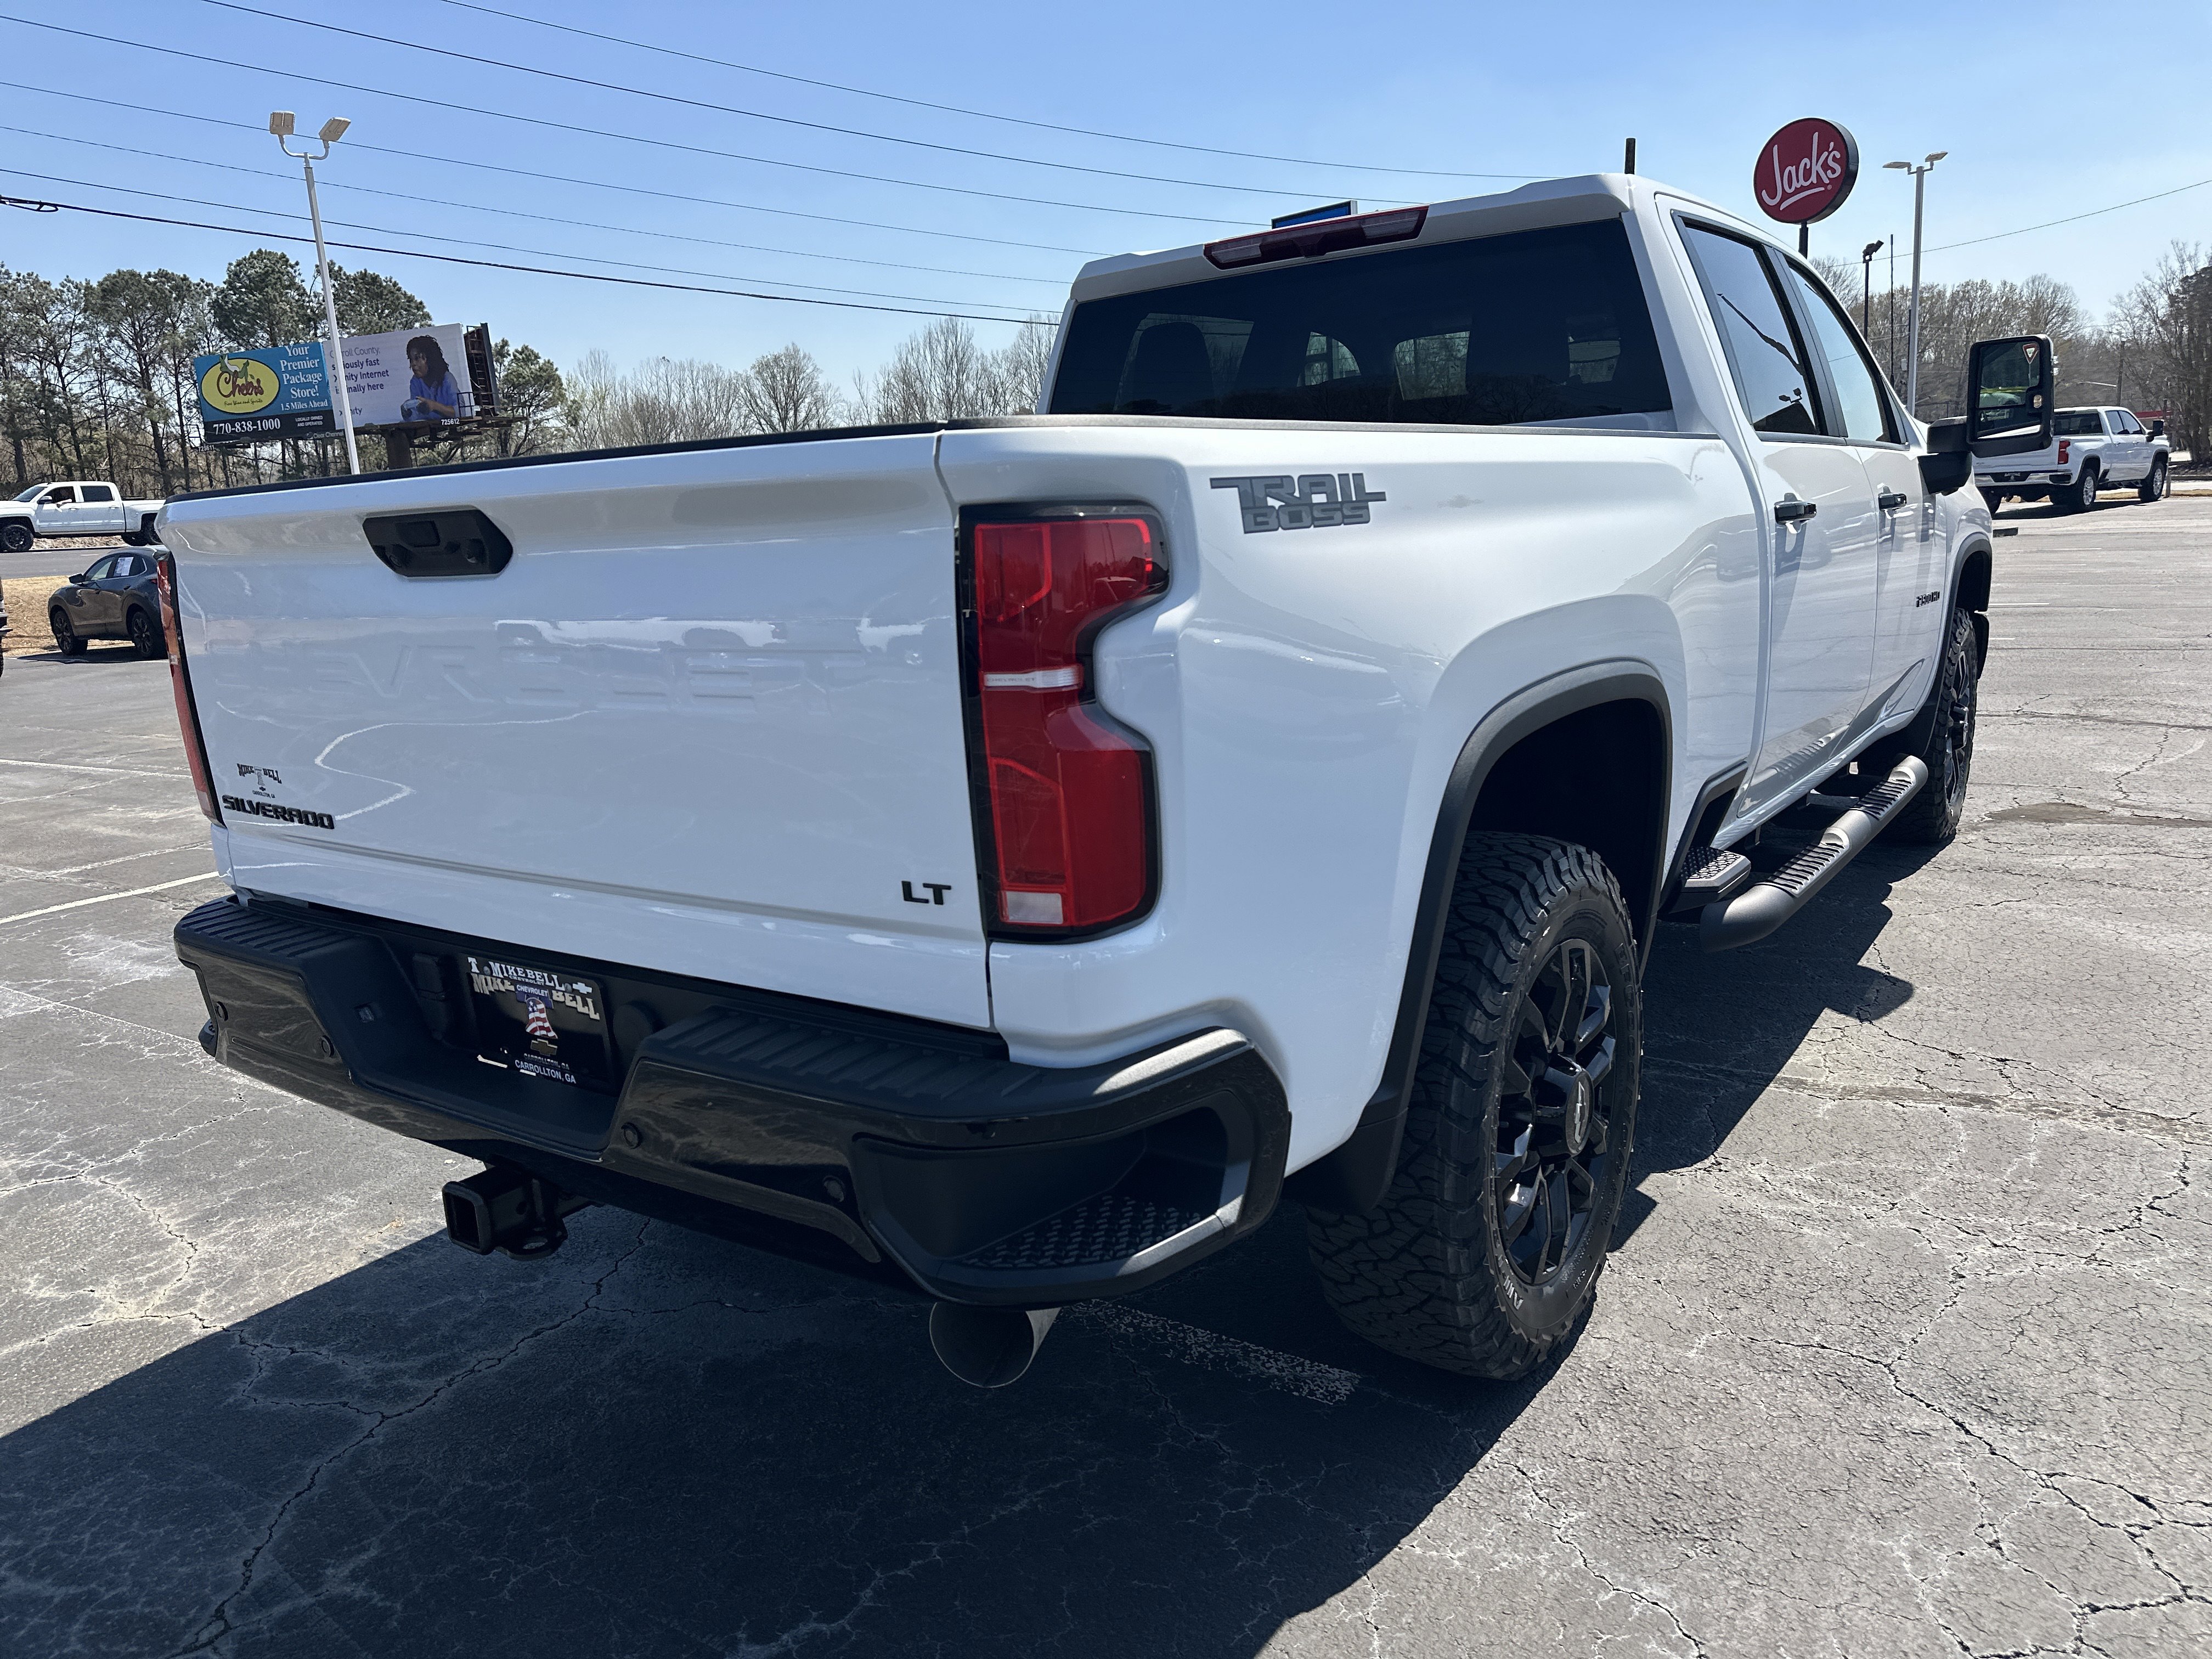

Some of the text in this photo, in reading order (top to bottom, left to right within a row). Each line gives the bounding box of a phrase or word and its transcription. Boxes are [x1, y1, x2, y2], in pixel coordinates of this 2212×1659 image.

[1762, 132, 1841, 206] Jack's
[285, 345, 309, 357] Your
[330, 347, 380, 359] Croll County,
[280, 357, 319, 371] Premier
[331, 358, 380, 370] siously fast
[283, 372, 322, 384] Package
[360, 370, 390, 380] Internet
[291, 385, 319, 399] Store!
[291, 401, 307, 410] Miles
[308, 399, 328, 408] Ahead
[213, 418, 281, 435] 770-838-1000
[1210, 472, 1386, 507] TRAIL
[1242, 501, 1370, 534] BOSS
[237, 763, 282, 784] MIKE BELL
[222, 794, 335, 830] SILVERADO
[901, 881, 952, 905] LT
[488, 961, 526, 978] MIKE
[527, 969, 566, 991] BELL
[509, 975, 544, 986] CHEVROLET
[471, 973, 600, 1021] MIKE BELL
[516, 984, 548, 996] CHEVROLET
[515, 1059, 576, 1084] CARROLLTON, GA
